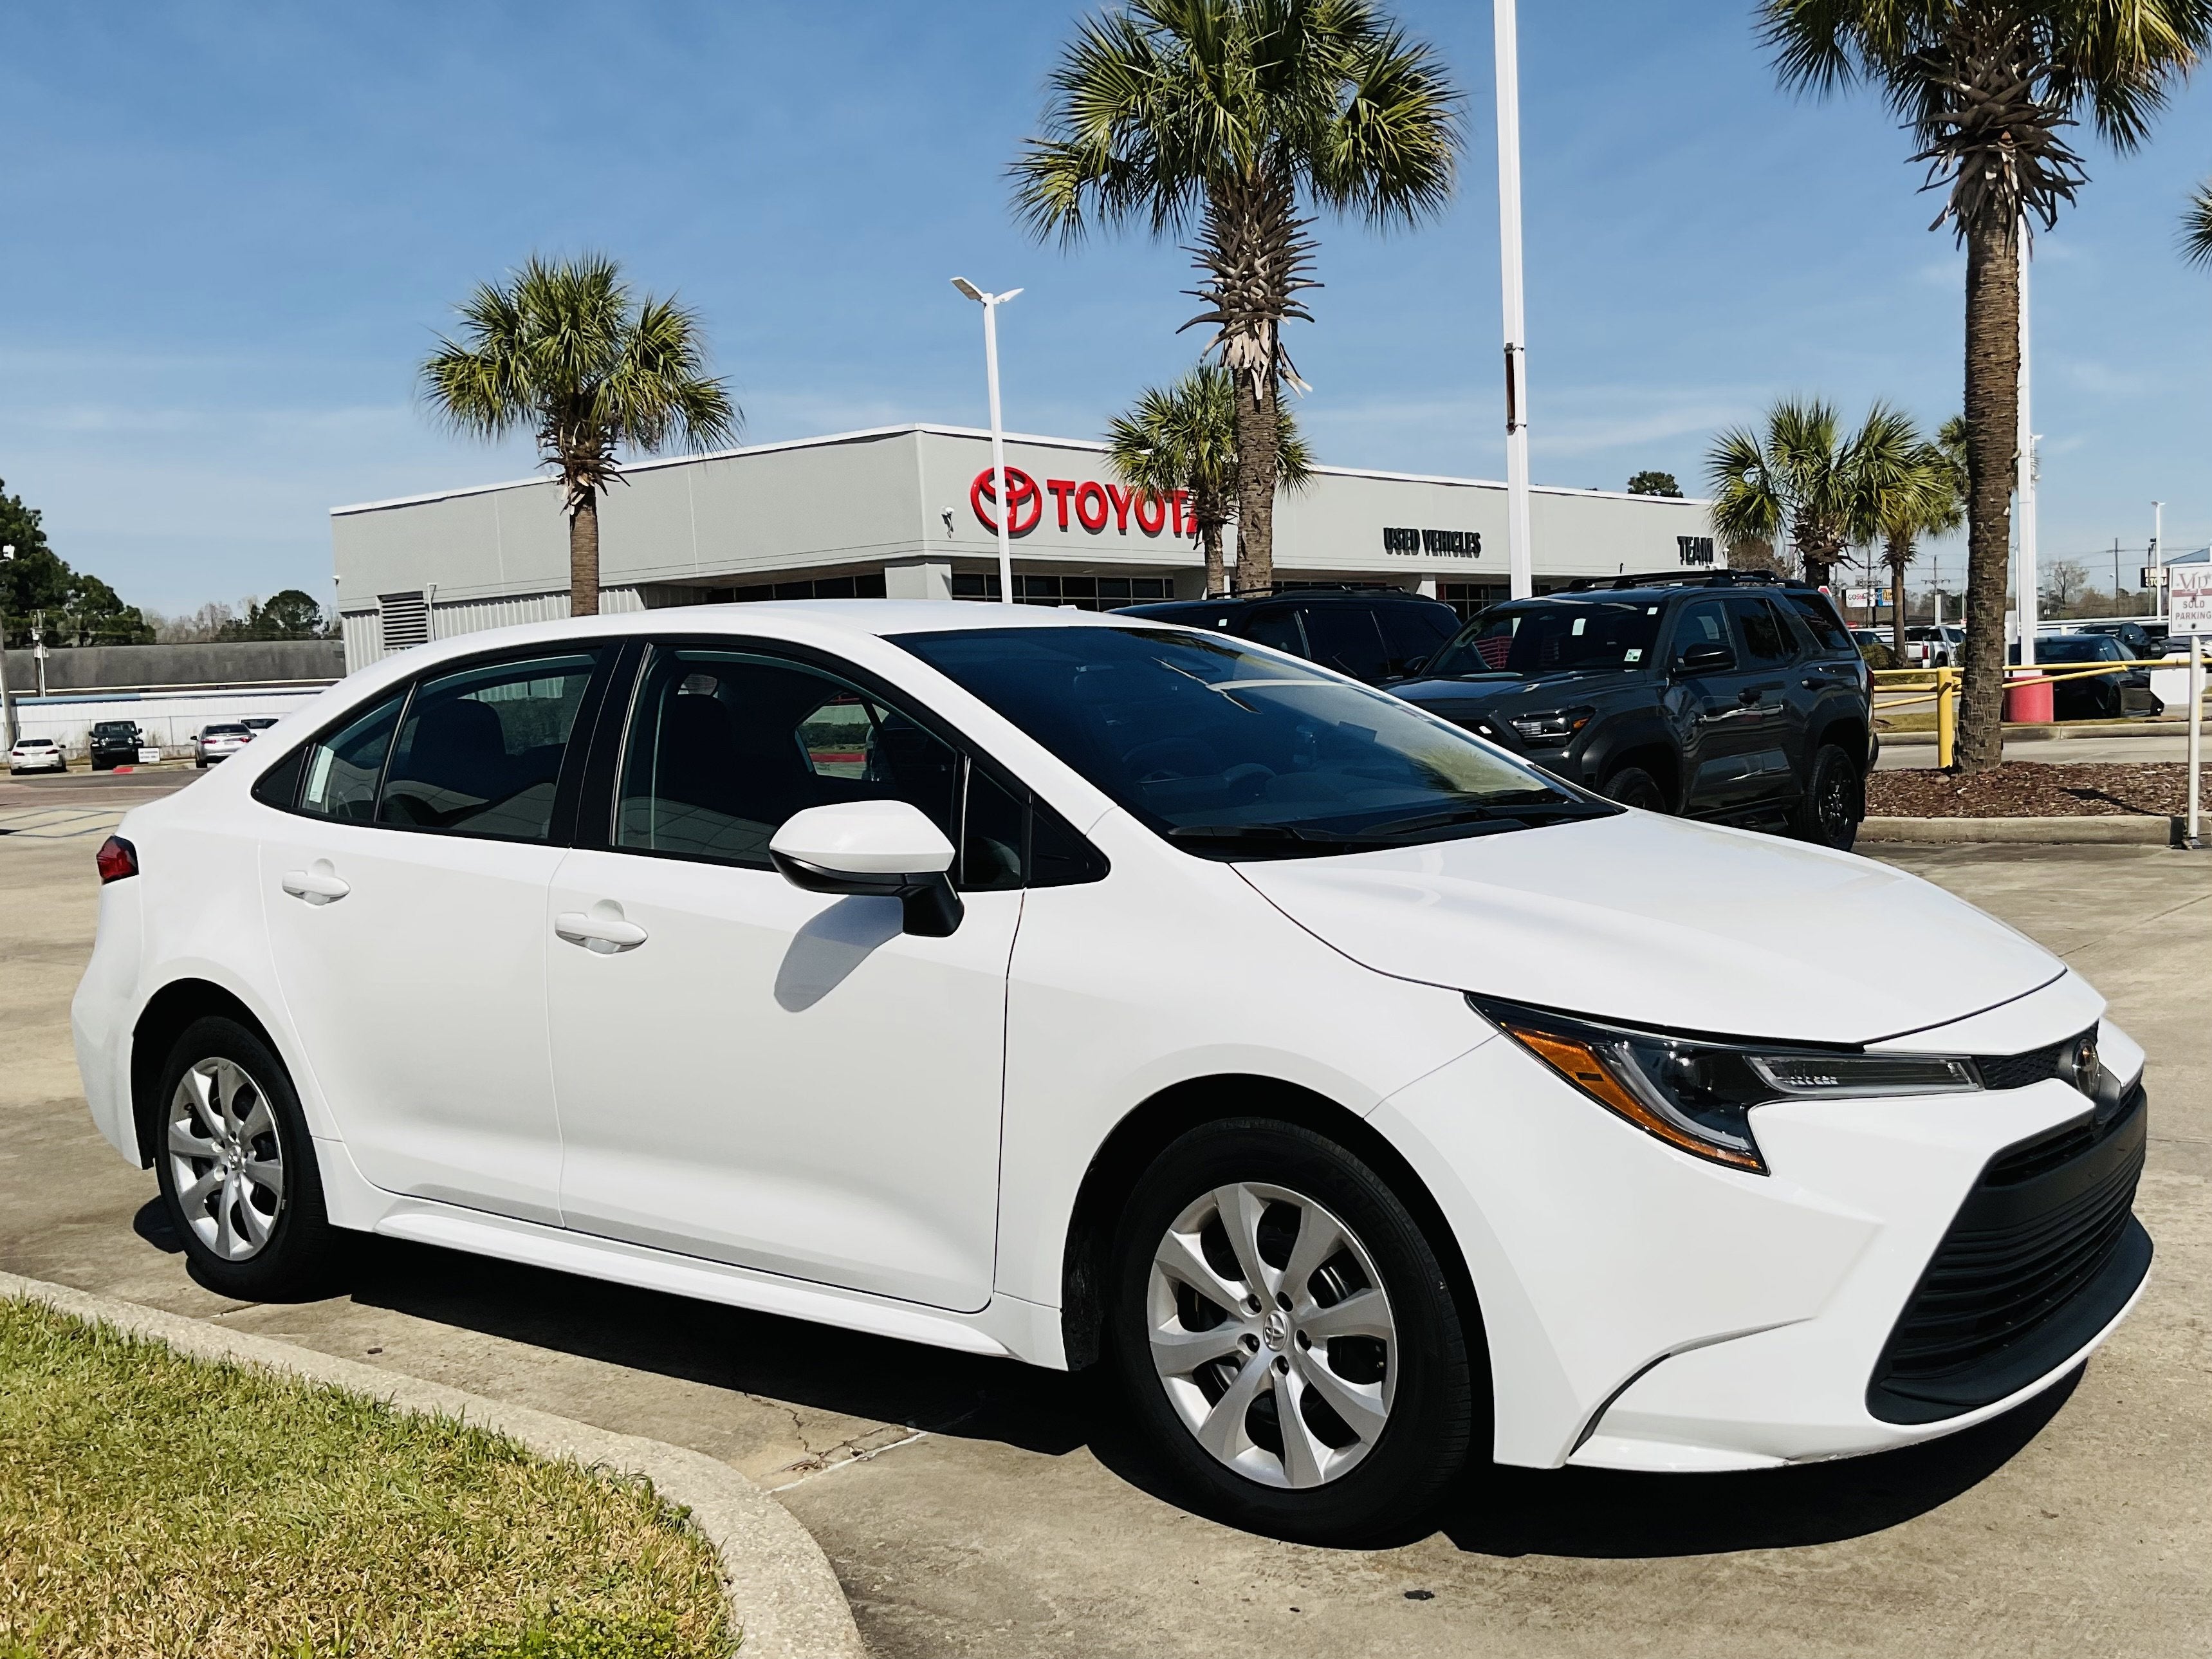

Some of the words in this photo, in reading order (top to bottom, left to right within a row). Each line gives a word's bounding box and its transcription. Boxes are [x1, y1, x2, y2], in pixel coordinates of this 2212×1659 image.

[1383, 528, 1420, 551] USED
[1421, 530, 1481, 554] VEHICLES
[1677, 536, 1713, 563] TEAM
[2183, 600, 2205, 609] SOLD
[2175, 611, 2212, 620] PARKING
